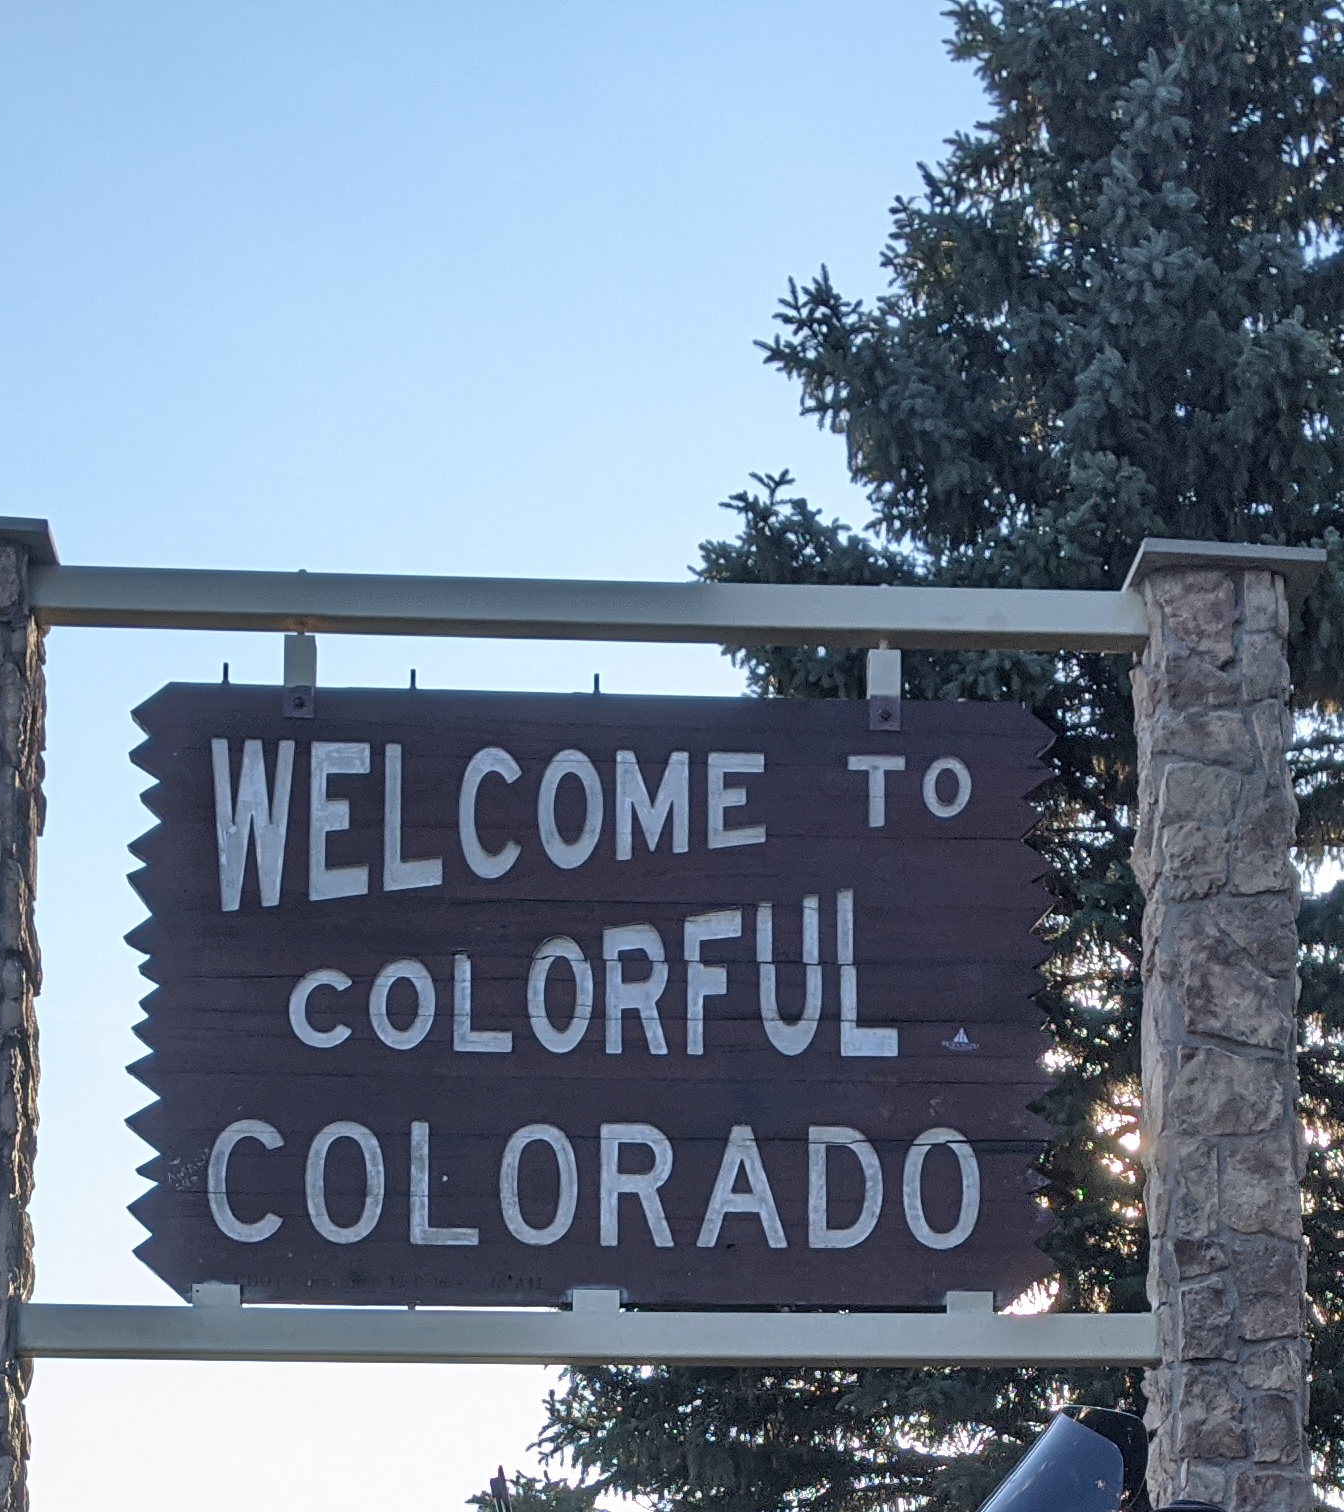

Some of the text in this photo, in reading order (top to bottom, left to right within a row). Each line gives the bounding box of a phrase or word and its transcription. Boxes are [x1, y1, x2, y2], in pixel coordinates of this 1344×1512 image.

[211, 738, 767, 912] WELCOME
[288, 890, 899, 1057] COLORFUL
[207, 1119, 981, 1250] COLORADO
